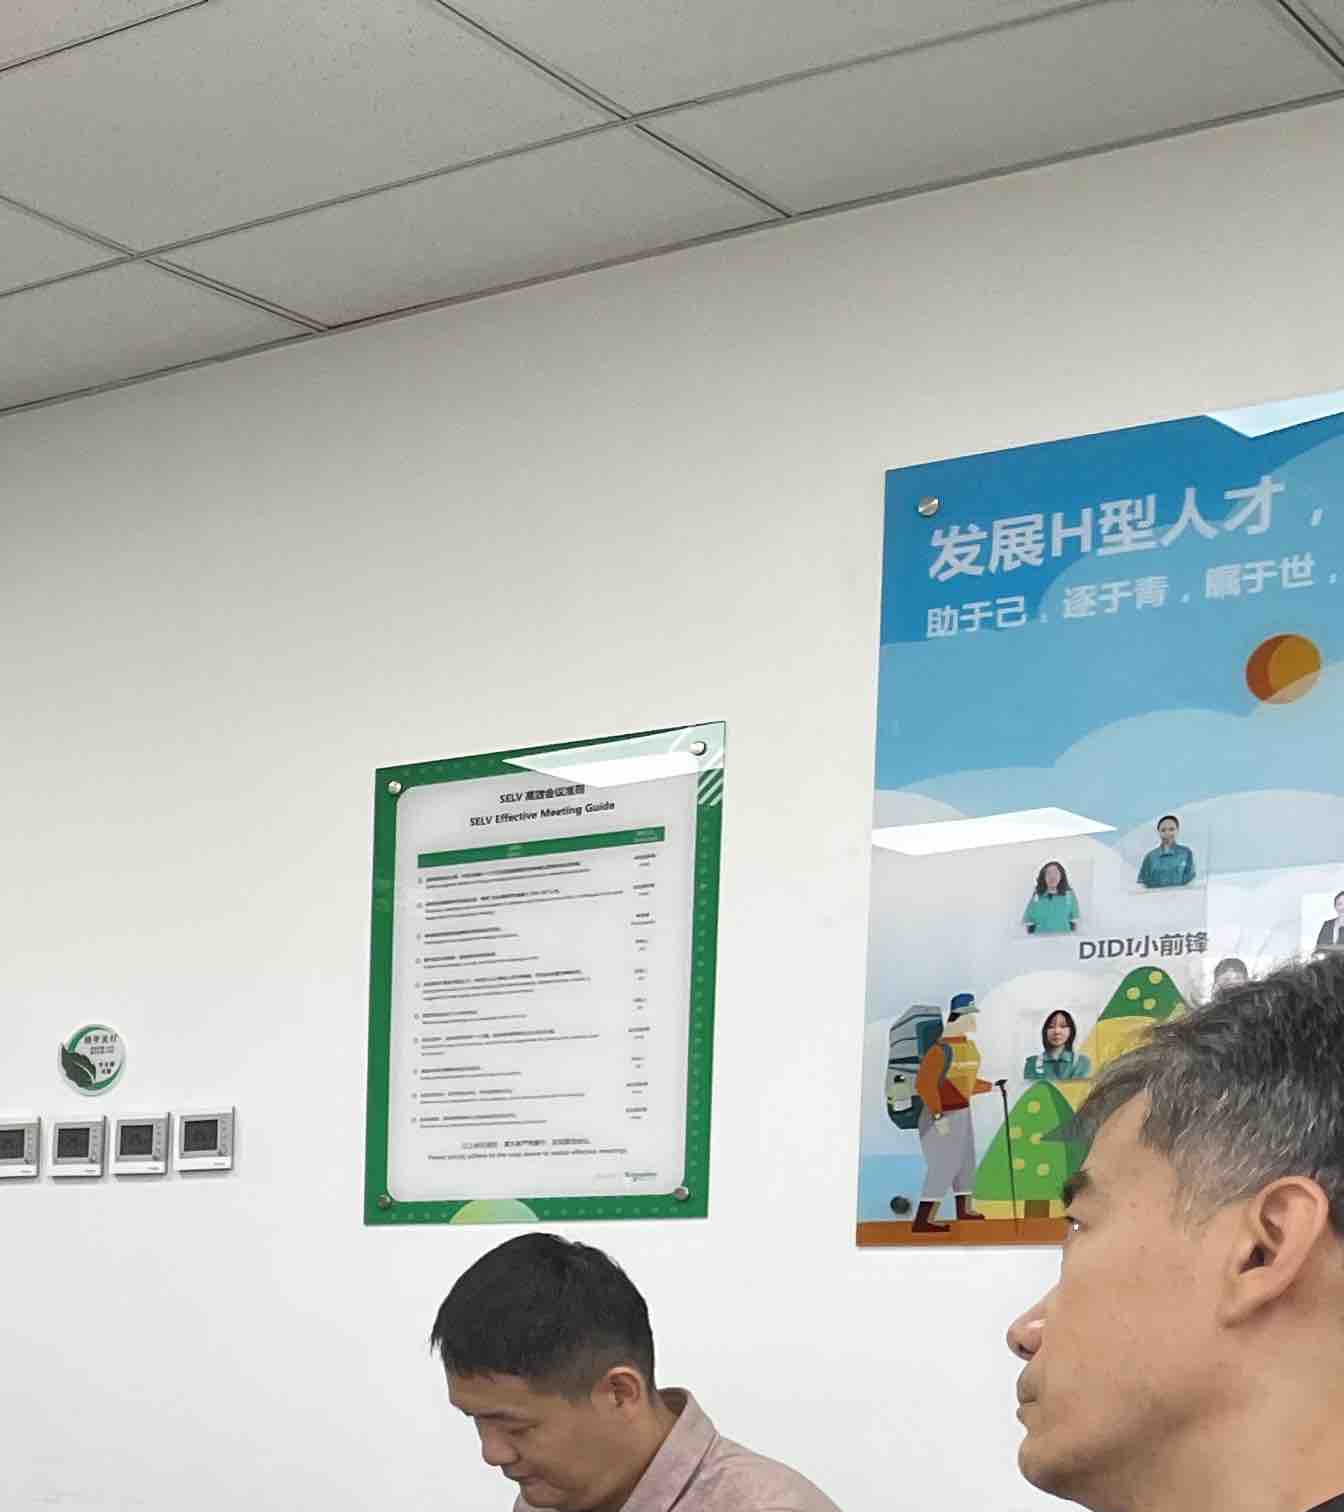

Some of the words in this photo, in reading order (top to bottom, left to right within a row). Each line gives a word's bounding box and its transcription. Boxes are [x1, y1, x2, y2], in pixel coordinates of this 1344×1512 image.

[469, 816, 492, 826] SELV
[495, 811, 537, 824] Effective
[540, 804, 582, 817] Meeting
[585, 801, 615, 813] Guide
[1079, 932, 1208, 959] DIDI小前锋
